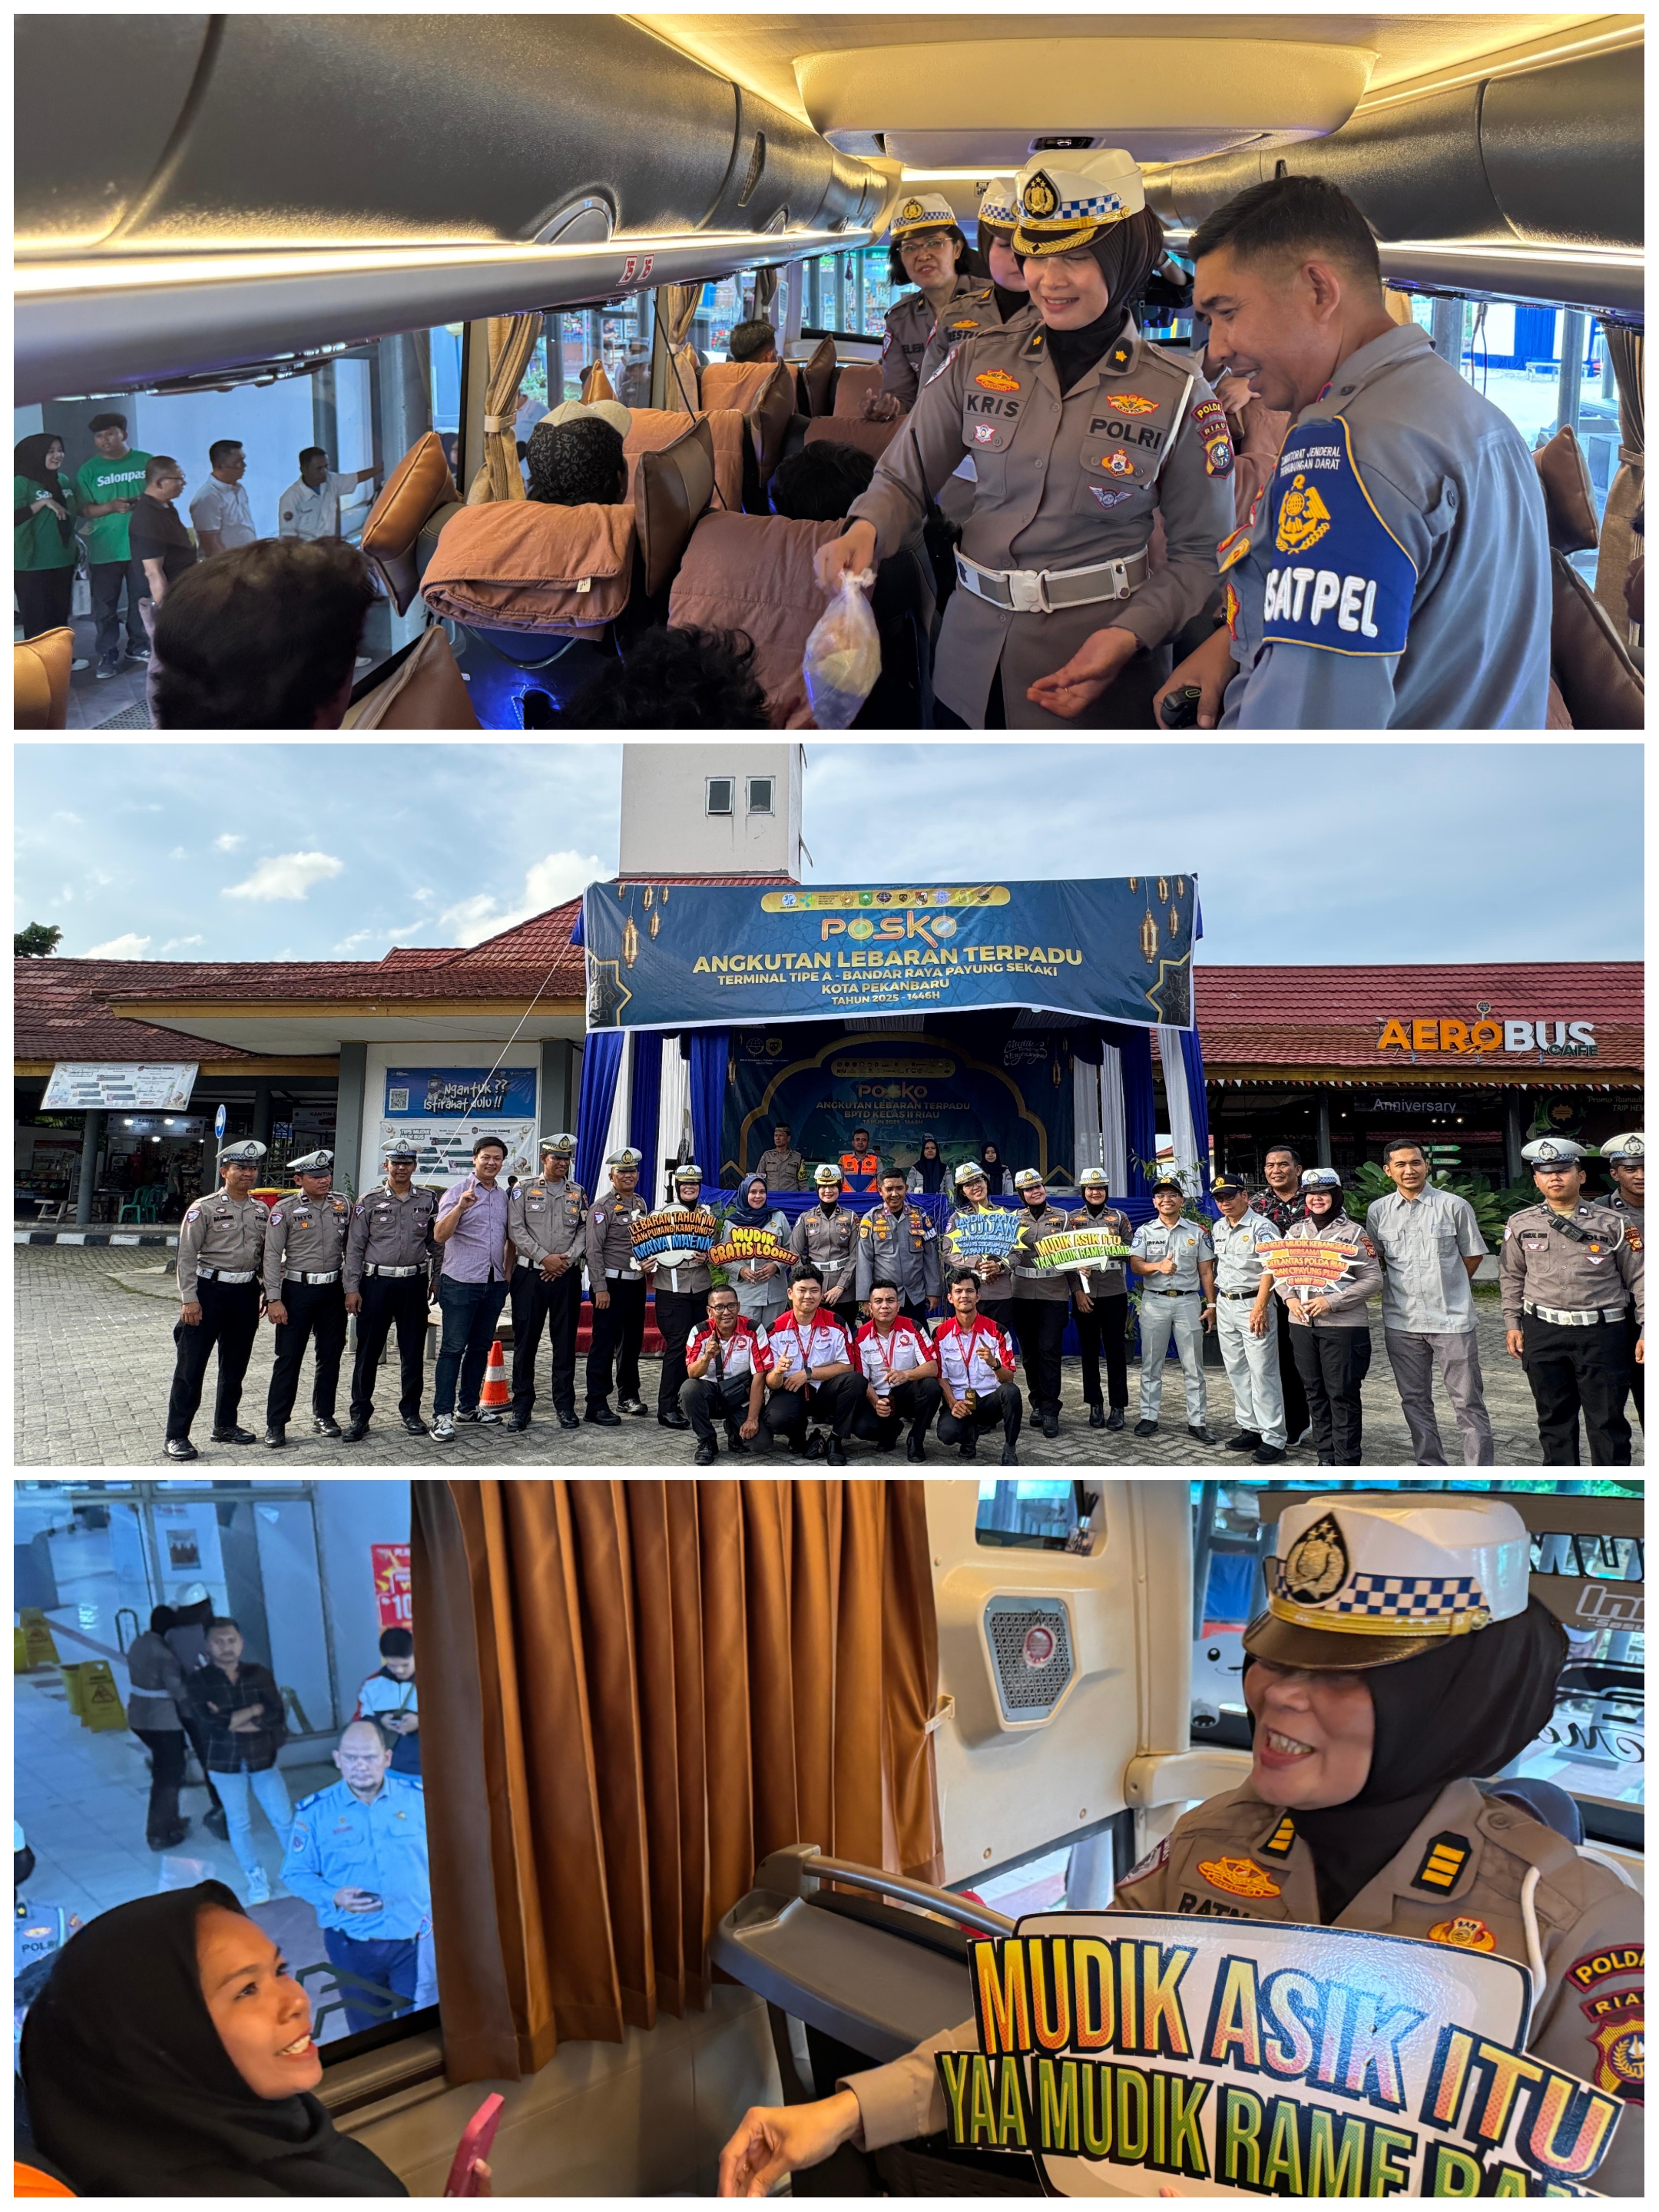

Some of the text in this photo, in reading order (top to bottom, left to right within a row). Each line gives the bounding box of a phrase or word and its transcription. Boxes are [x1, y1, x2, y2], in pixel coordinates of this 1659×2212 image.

[966, 393, 1020, 418] KRIS
[1197, 402, 1223, 419] POLDA
[1089, 418, 1162, 450] POLRI
[1204, 422, 1226, 435] RIAU
[1306, 446, 1341, 458] JENDERAL
[1314, 458, 1340, 470] DARAT
[97, 470, 146, 487] Salonpas
[1263, 566, 1379, 638] SATPEL
[821, 910, 957, 948] POSKO
[692, 945, 1083, 973] ANGKUTAN LEBARAN TERPADU
[717, 972, 786, 985] TERMINAL
[790, 971, 819, 982] TIPE
[822, 972, 833, 982] A
[843, 969, 902, 980] BANDAR
[905, 967, 942, 979] RAYA
[945, 963, 1004, 976] PAYUNG
[1006, 962, 1058, 976] SEKAKI
[822, 979, 950, 995] KOTA PEKANBARU
[831, 996, 870, 1005] TAHUN
[873, 992, 899, 1002] 2025
[907, 991, 940, 1001] 1446H
[1377, 1018, 1597, 1054] AEROBUS
[1547, 1044, 1598, 1057] CAFE
[444, 1081, 492, 1098] Ngantuk
[423, 1098, 469, 1113] Istirahat
[873, 1101, 922, 1110] LEBARAN
[1373, 1098, 1456, 1114] Anniversary
[628, 1212, 671, 1235] LEBARAN
[955, 1213, 1022, 1227] MUDIK GRATIS
[632, 1232, 648, 1244] GAK
[647, 1224, 674, 1237] PULANG
[731, 1227, 776, 1246] MUDIK
[957, 1221, 1019, 1238] TUJUAN
[633, 1236, 670, 1259] MANA
[1035, 1233, 1122, 1257] MUDIK ASIK ITU
[1286, 1240, 1309, 1248] MUDIK
[1289, 1248, 1320, 1257] BERSAMA
[1033, 1245, 1131, 1270] YAA MUDIK RAME RAME
[1267, 1258, 1304, 1268] DITLANTAS
[1304, 1257, 1330, 1267] POLDA
[1274, 1267, 1289, 1277] DAN
[1457, 1920, 1477, 1931] SAR
[1594, 1992, 1644, 2015] RIA
[974, 1939, 1615, 2174] MUDIK ASIK ITU
[942, 2055, 1028, 2146] YAA
[1039, 2060, 1211, 2175] MUDIK
